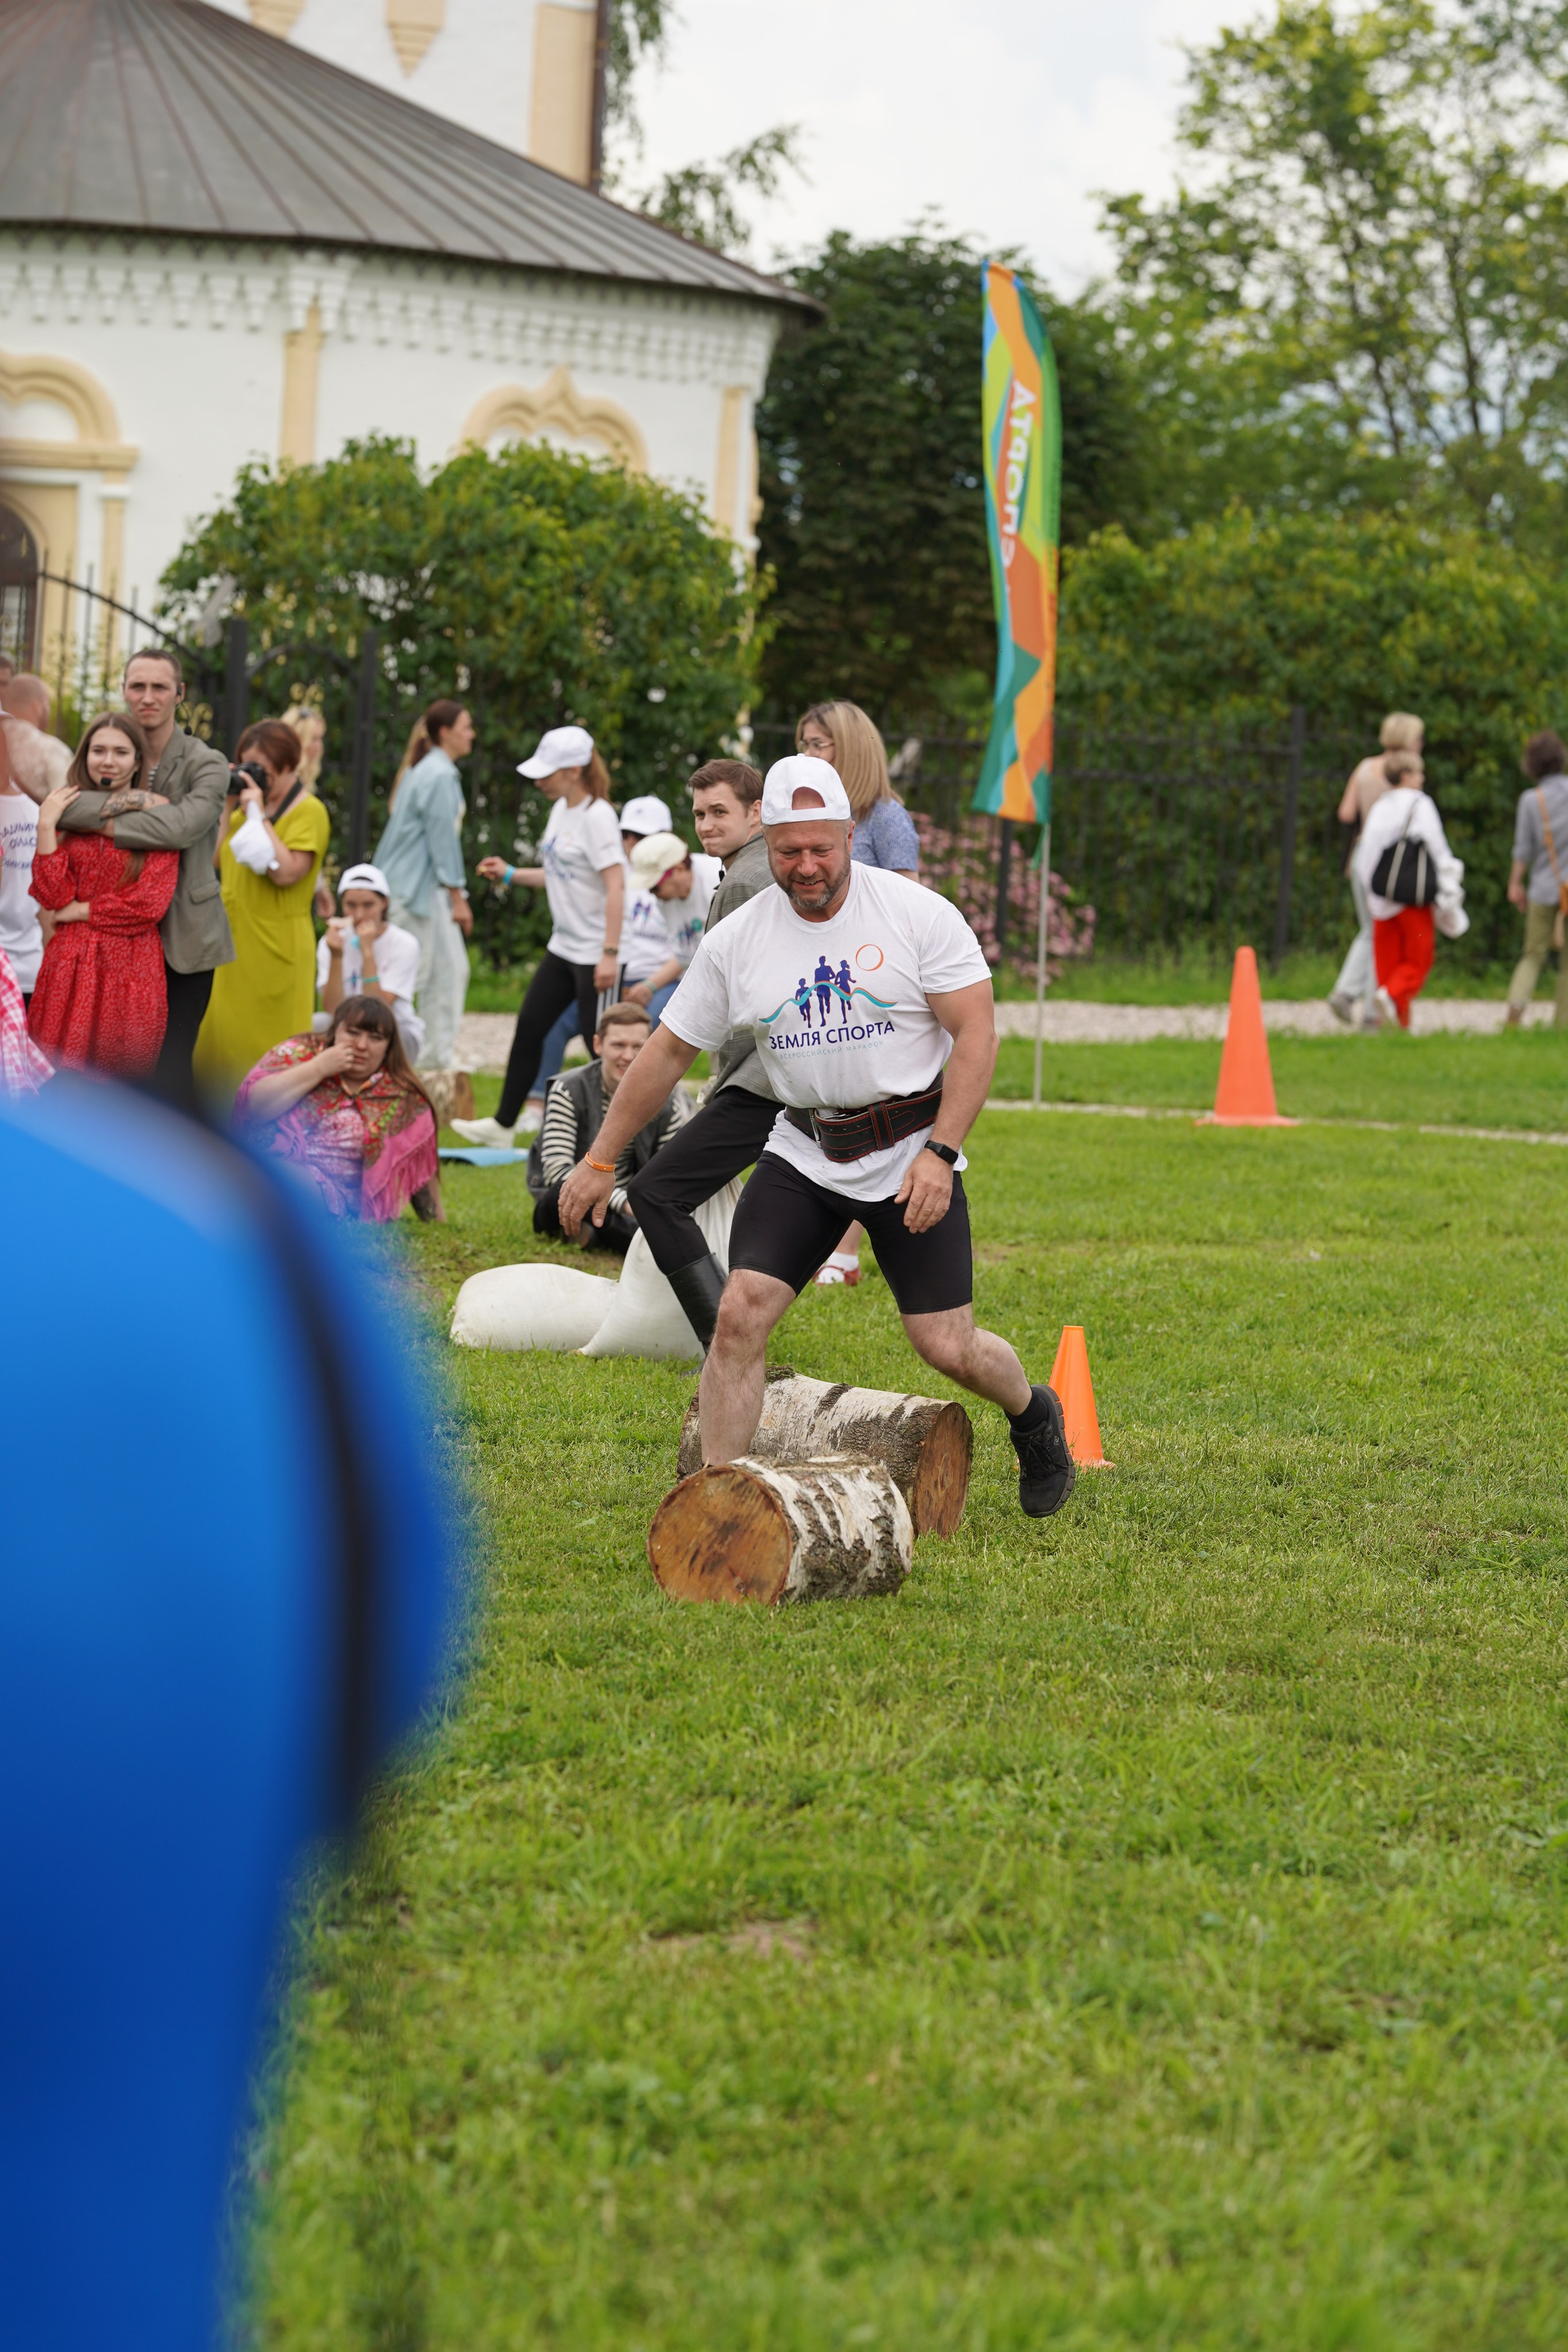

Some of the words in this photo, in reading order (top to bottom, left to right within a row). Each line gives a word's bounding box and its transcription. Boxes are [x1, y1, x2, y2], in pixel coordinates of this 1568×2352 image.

[769, 1031, 821, 1050] ЗЕМЛЯ
[826, 1020, 895, 1044] СПОРТА
[780, 1046, 843, 1060] ВСЕРОССИЙСКИЙ
[846, 1040, 884, 1052] МАРАФОН
